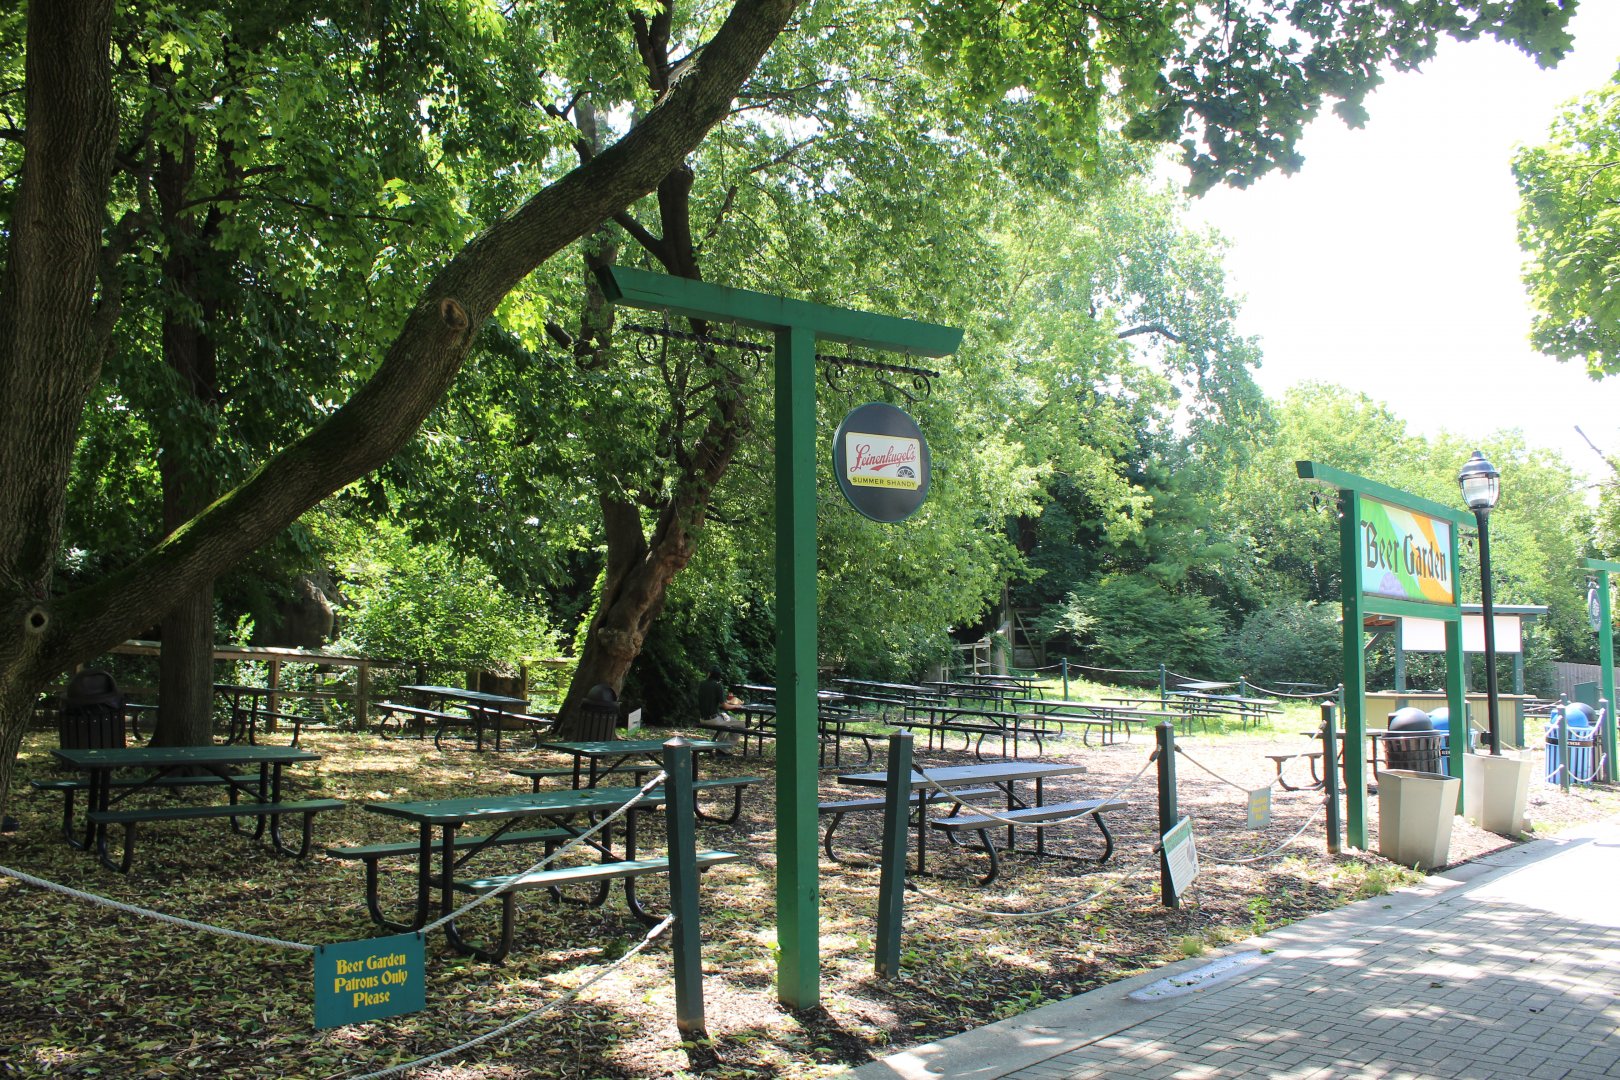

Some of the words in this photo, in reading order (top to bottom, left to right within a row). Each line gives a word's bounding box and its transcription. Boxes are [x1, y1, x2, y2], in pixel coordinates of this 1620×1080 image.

[852, 477, 884, 485] SUMMER
[886, 479, 915, 487] SHANDY
[1361, 519, 1399, 573] Beer
[1403, 534, 1447, 582] Garden
[336, 959, 364, 975] Beer
[366, 953, 406, 970] Garden
[334, 975, 379, 993] Patrons
[381, 969, 408, 986] Only
[353, 991, 391, 1008] Please
